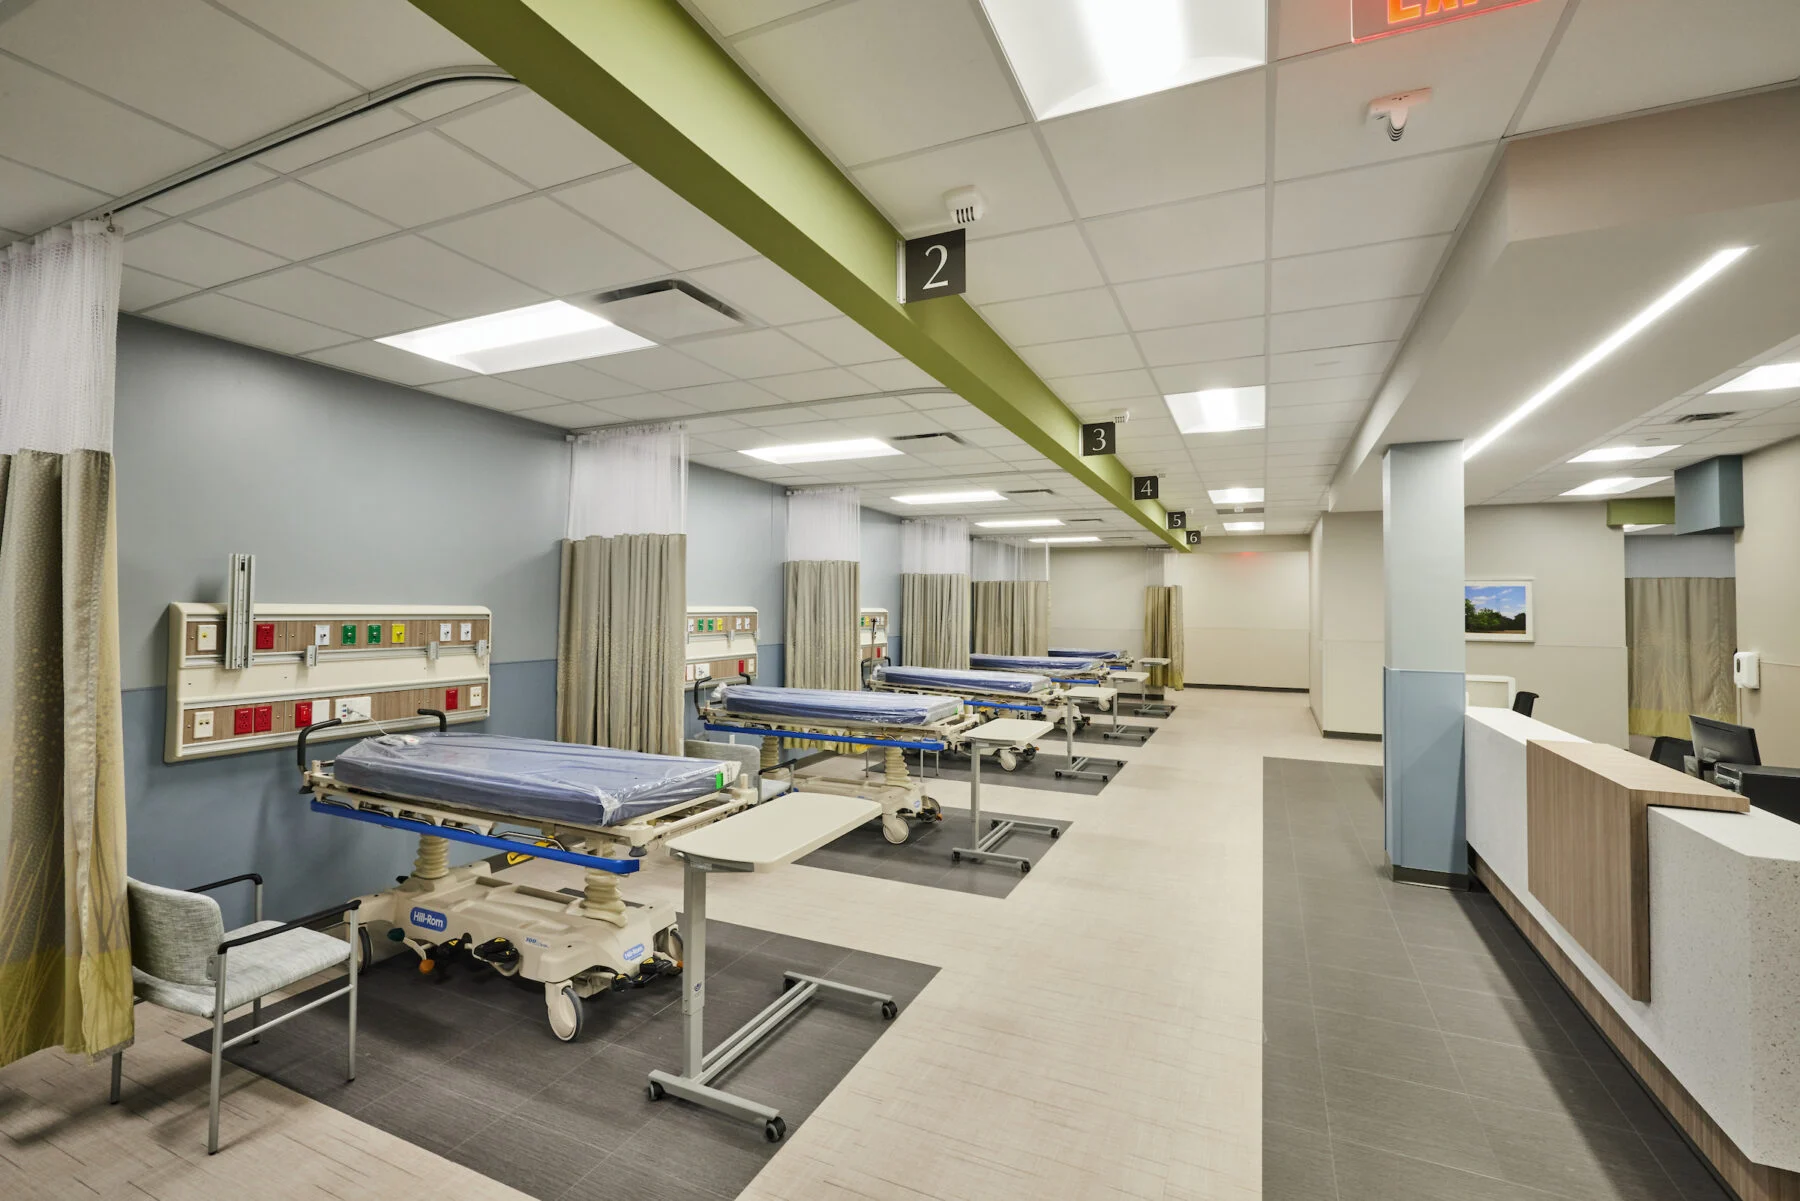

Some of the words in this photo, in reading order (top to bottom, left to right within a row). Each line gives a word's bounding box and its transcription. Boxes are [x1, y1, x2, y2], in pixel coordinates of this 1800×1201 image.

[922, 244, 949, 290] 2
[1092, 428, 1107, 451] 3
[1140, 480, 1153, 496] 4
[1172, 514, 1182, 527] 5
[1189, 532, 1198, 543] 6
[413, 910, 444, 928] Hill-Rom
